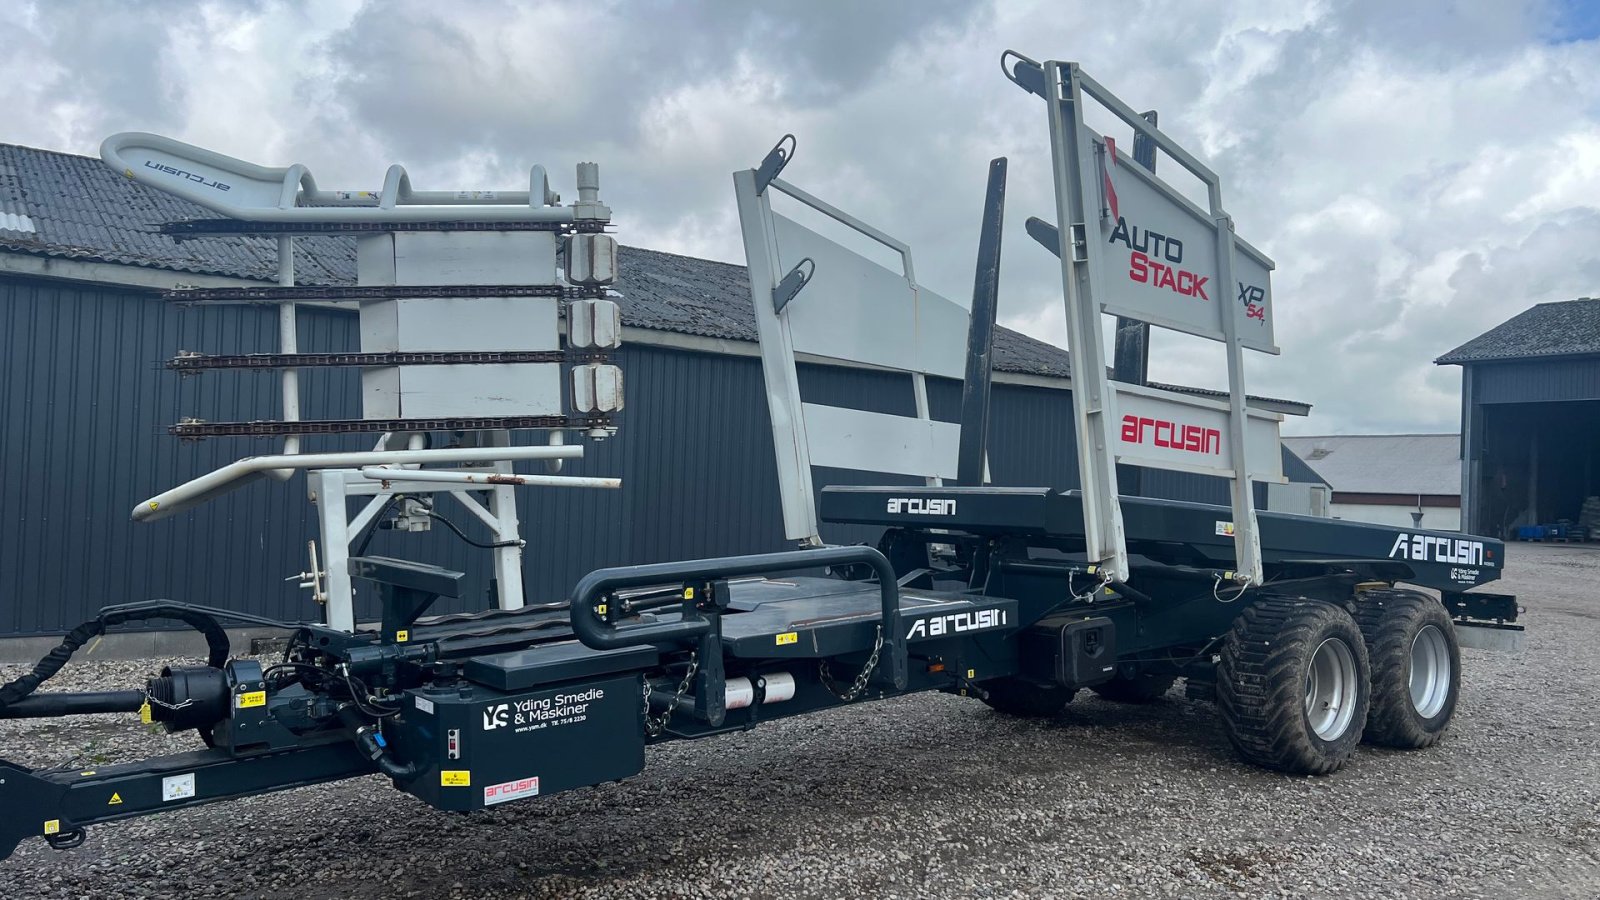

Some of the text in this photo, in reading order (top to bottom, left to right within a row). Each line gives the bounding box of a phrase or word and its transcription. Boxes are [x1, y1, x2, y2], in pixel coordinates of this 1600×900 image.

[144, 160, 231, 192] arcusin
[1108, 215, 1183, 264] AUTO
[1129, 250, 1209, 301] STACK
[1238, 281, 1265, 307] XP
[1246, 303, 1265, 320] 54
[1120, 414, 1221, 455] arcusin
[887, 497, 957, 516] arcusin
[1411, 534, 1484, 566] arcusin
[929, 608, 1007, 636] arcusin
[513, 688, 604, 712] Yding Smedie
[514, 703, 589, 725] & Maskiner
[486, 778, 537, 797] arcusin
